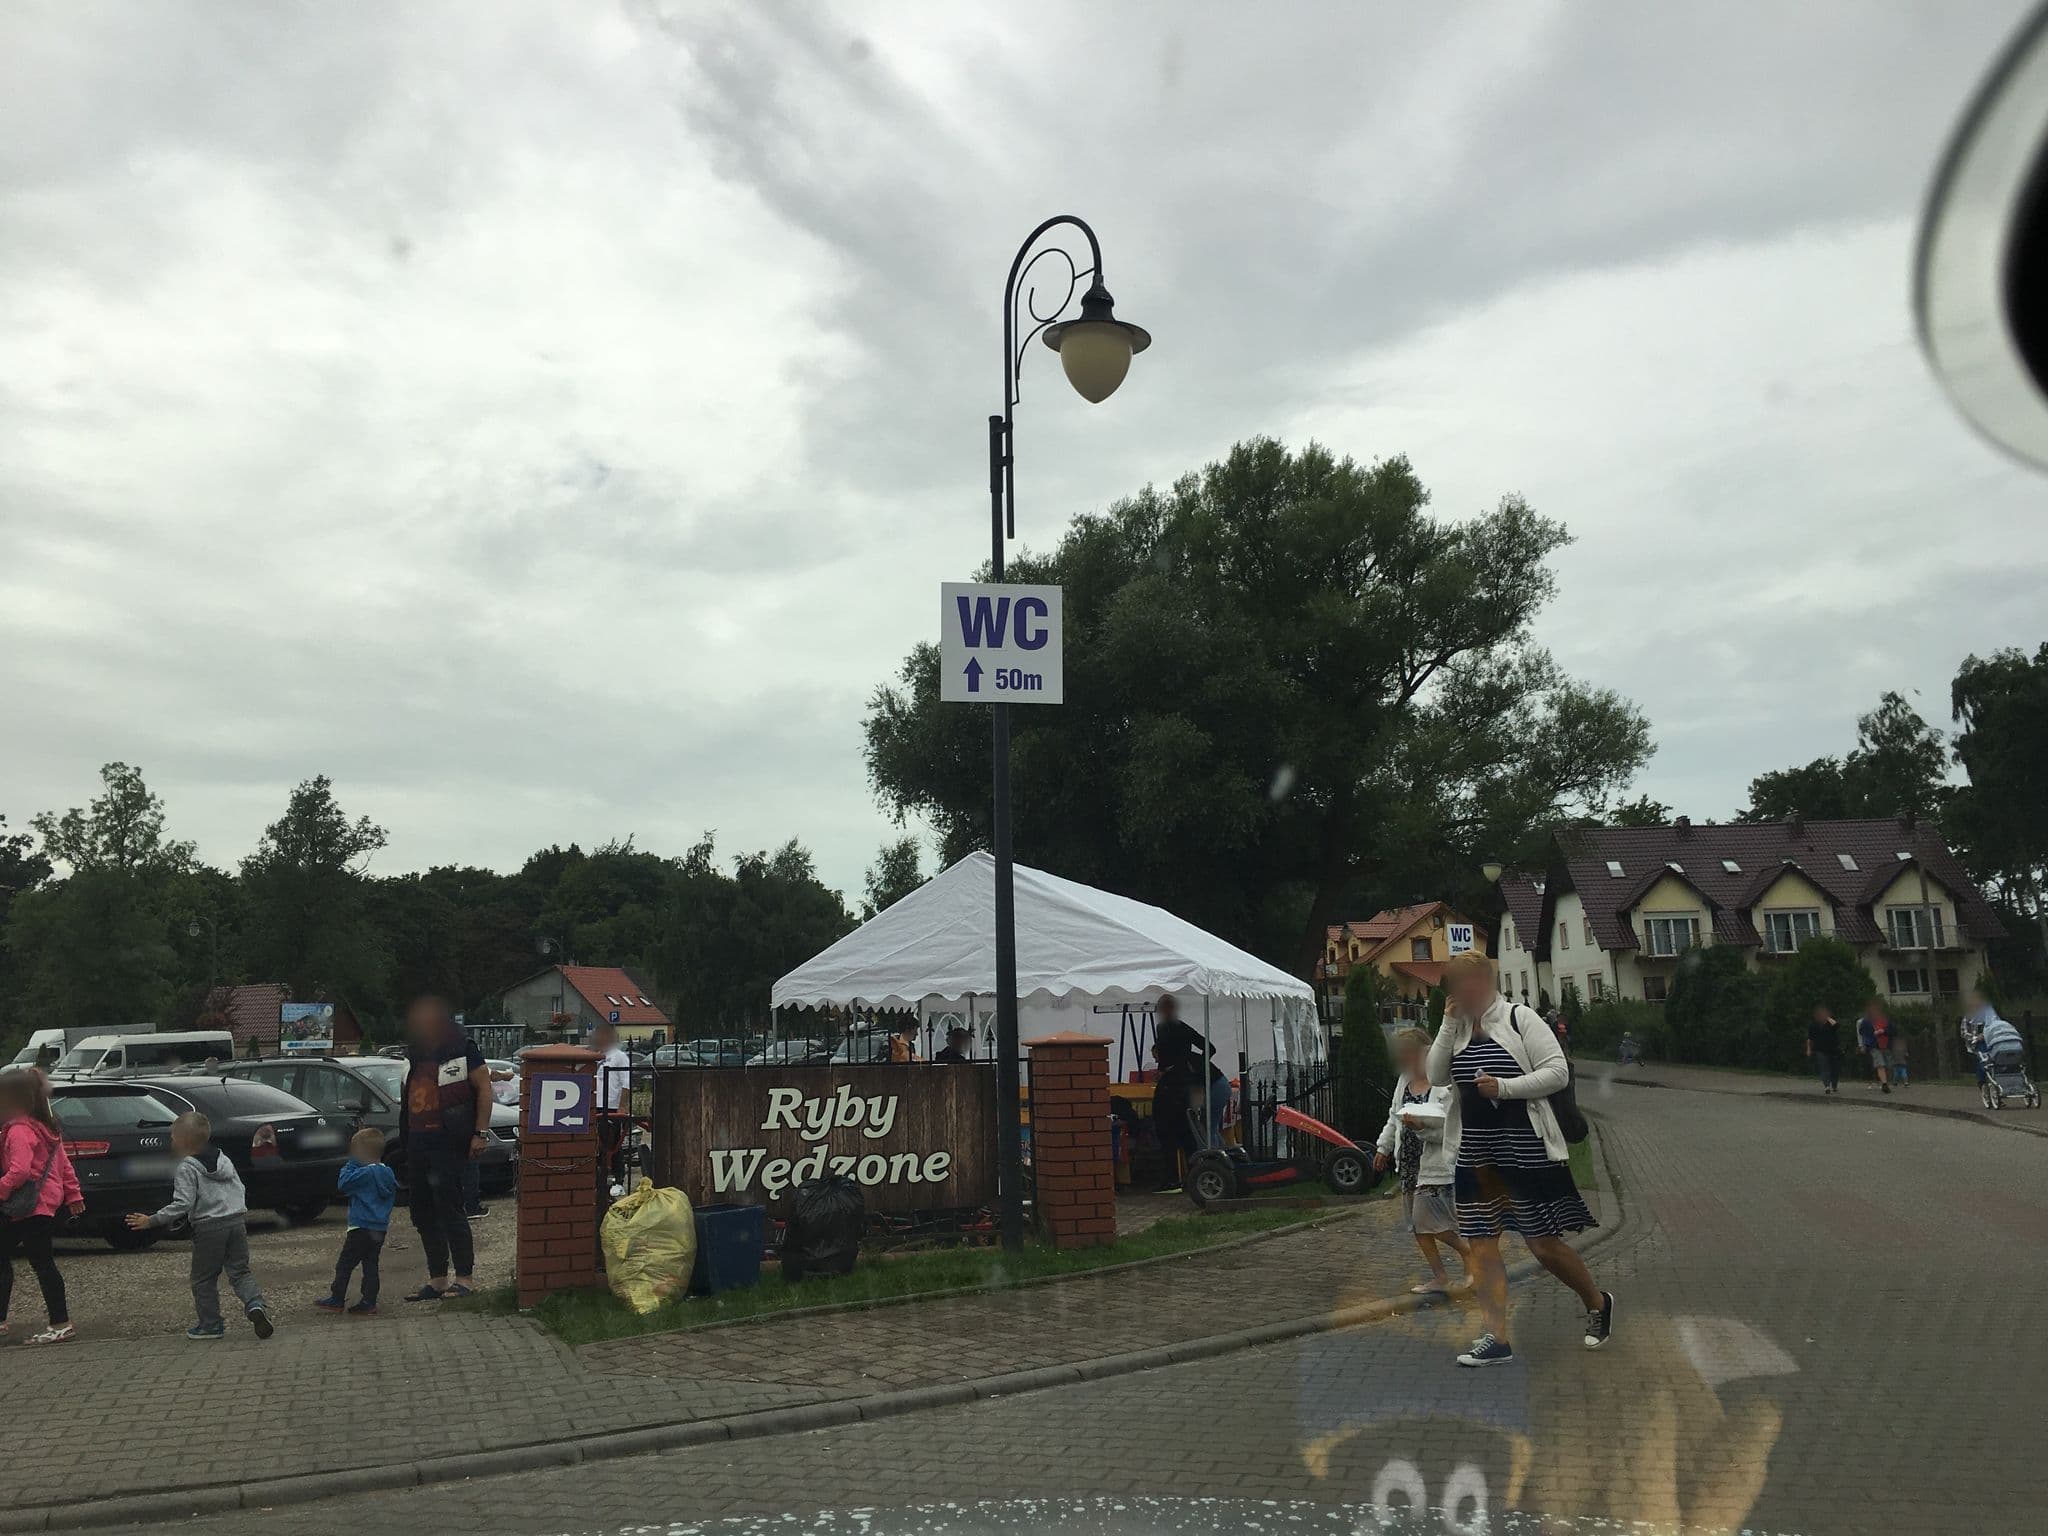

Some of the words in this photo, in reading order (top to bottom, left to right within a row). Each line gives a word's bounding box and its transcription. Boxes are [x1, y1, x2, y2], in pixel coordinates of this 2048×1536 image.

[957, 596, 1048, 650] WC
[995, 668, 1042, 690] 50m
[1450, 927, 1471, 942] WC
[611, 1012, 618, 1021] P
[539, 1080, 580, 1126] P
[760, 1084, 899, 1141] Ryby
[708, 1144, 952, 1201] Wędzone
